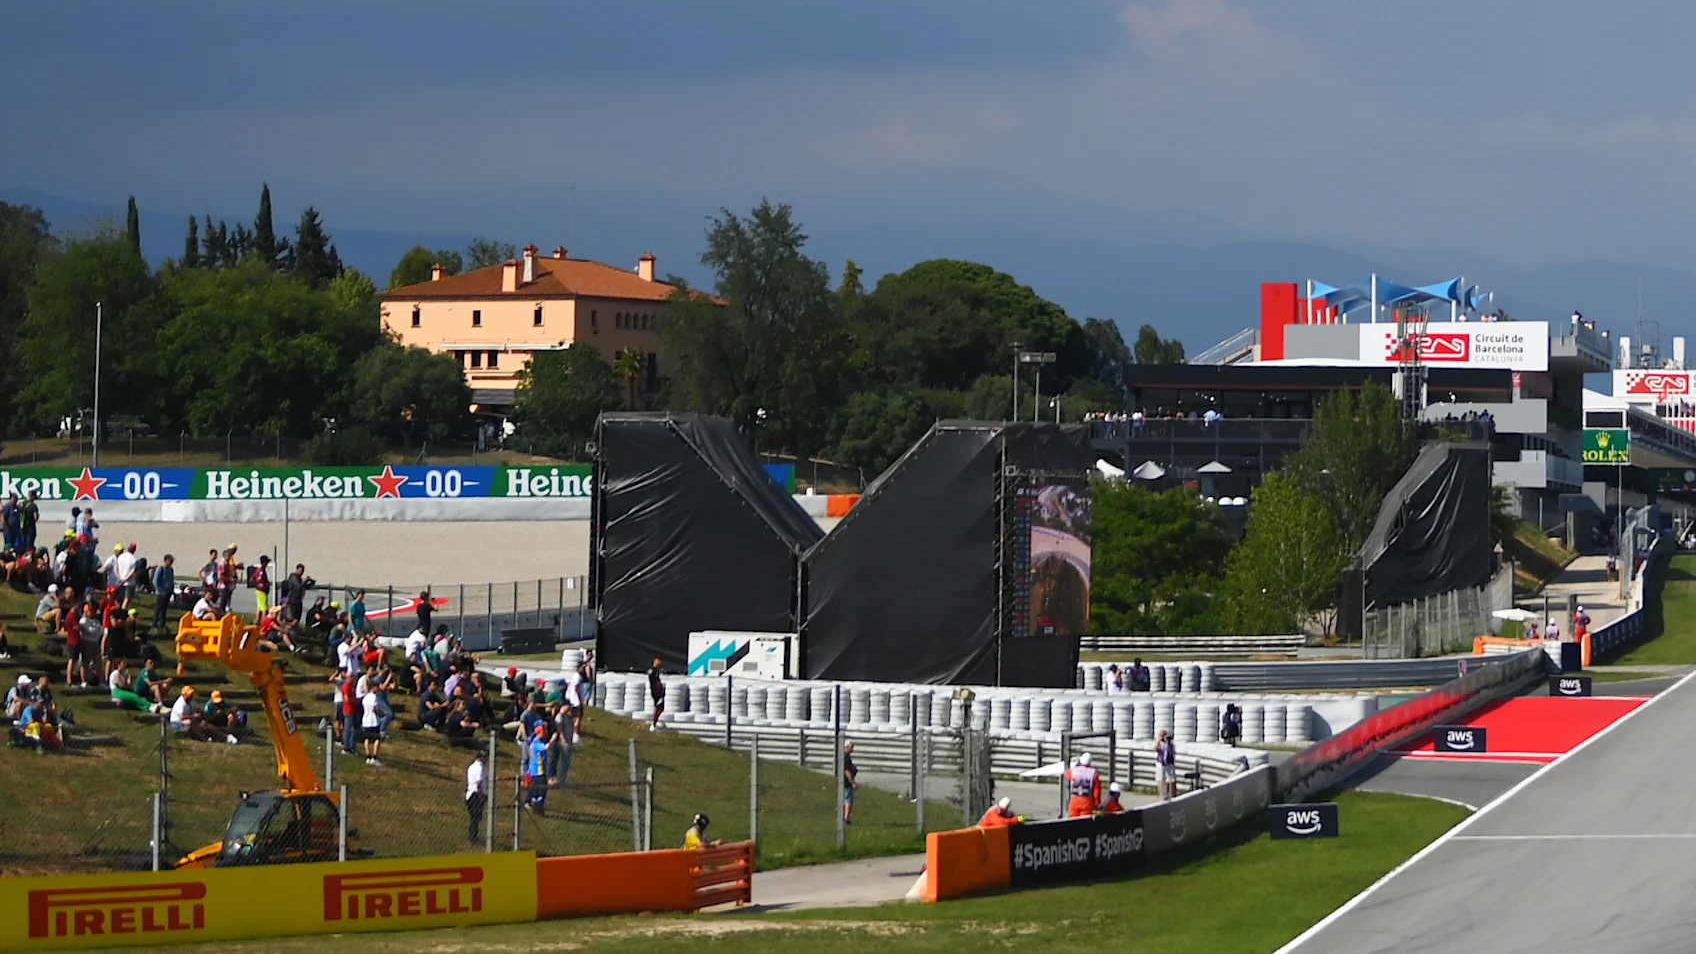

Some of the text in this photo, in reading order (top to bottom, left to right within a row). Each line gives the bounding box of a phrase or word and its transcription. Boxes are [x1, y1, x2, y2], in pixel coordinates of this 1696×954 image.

[1475, 333, 1524, 343] Circuit de
[1475, 344, 1523, 353] Barcelona
[1474, 355, 1523, 363] CATALUNYA
[206, 470, 364, 499] Heineken
[1559, 678, 1581, 689] aws
[277, 697, 297, 735] JCB
[1446, 730, 1473, 742] aws
[1287, 810, 1321, 825] aws
[1013, 827, 1144, 871] #SpanishGP #SpanishGP
[323, 866, 485, 921] PIRELLI
[28, 881, 207, 938] PIRELLI
